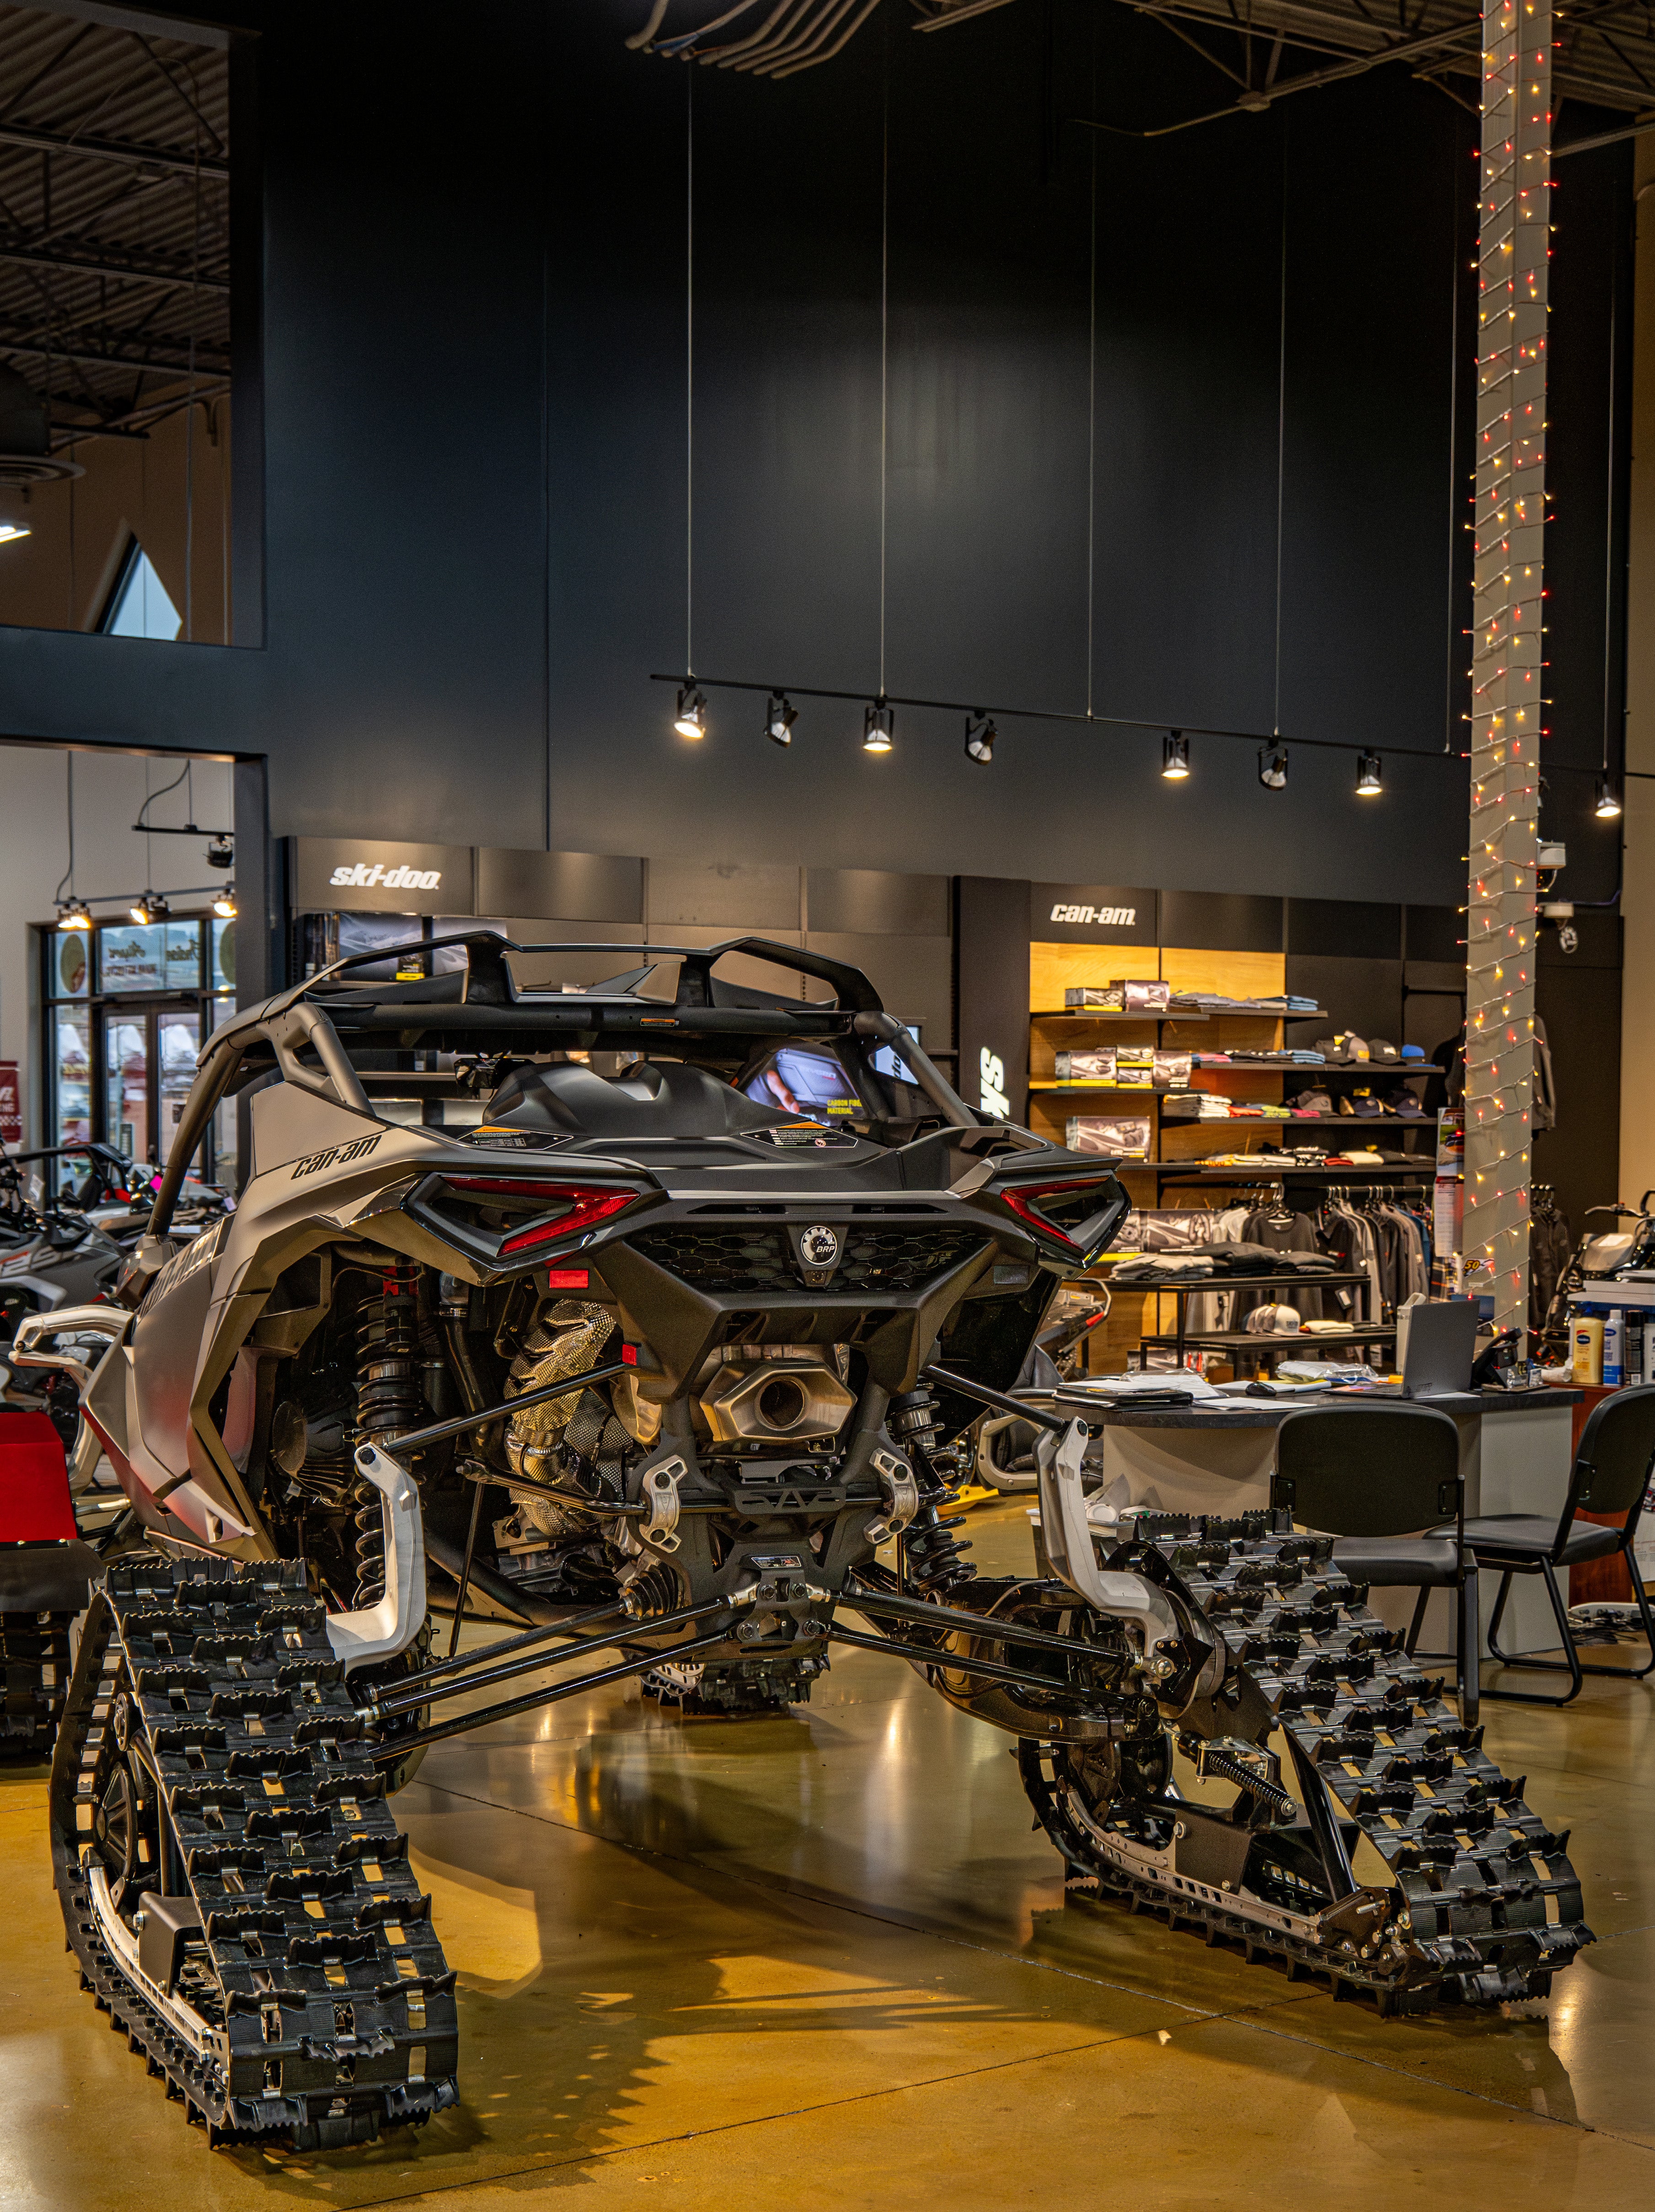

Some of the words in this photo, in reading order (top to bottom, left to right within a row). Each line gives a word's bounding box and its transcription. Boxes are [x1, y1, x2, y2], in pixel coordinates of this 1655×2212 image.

[329, 863, 442, 890] ski-doo
[1050, 904, 1135, 925] can-am
[291, 1134, 382, 1180] can-am
[1464, 1260, 1480, 1270] 50
